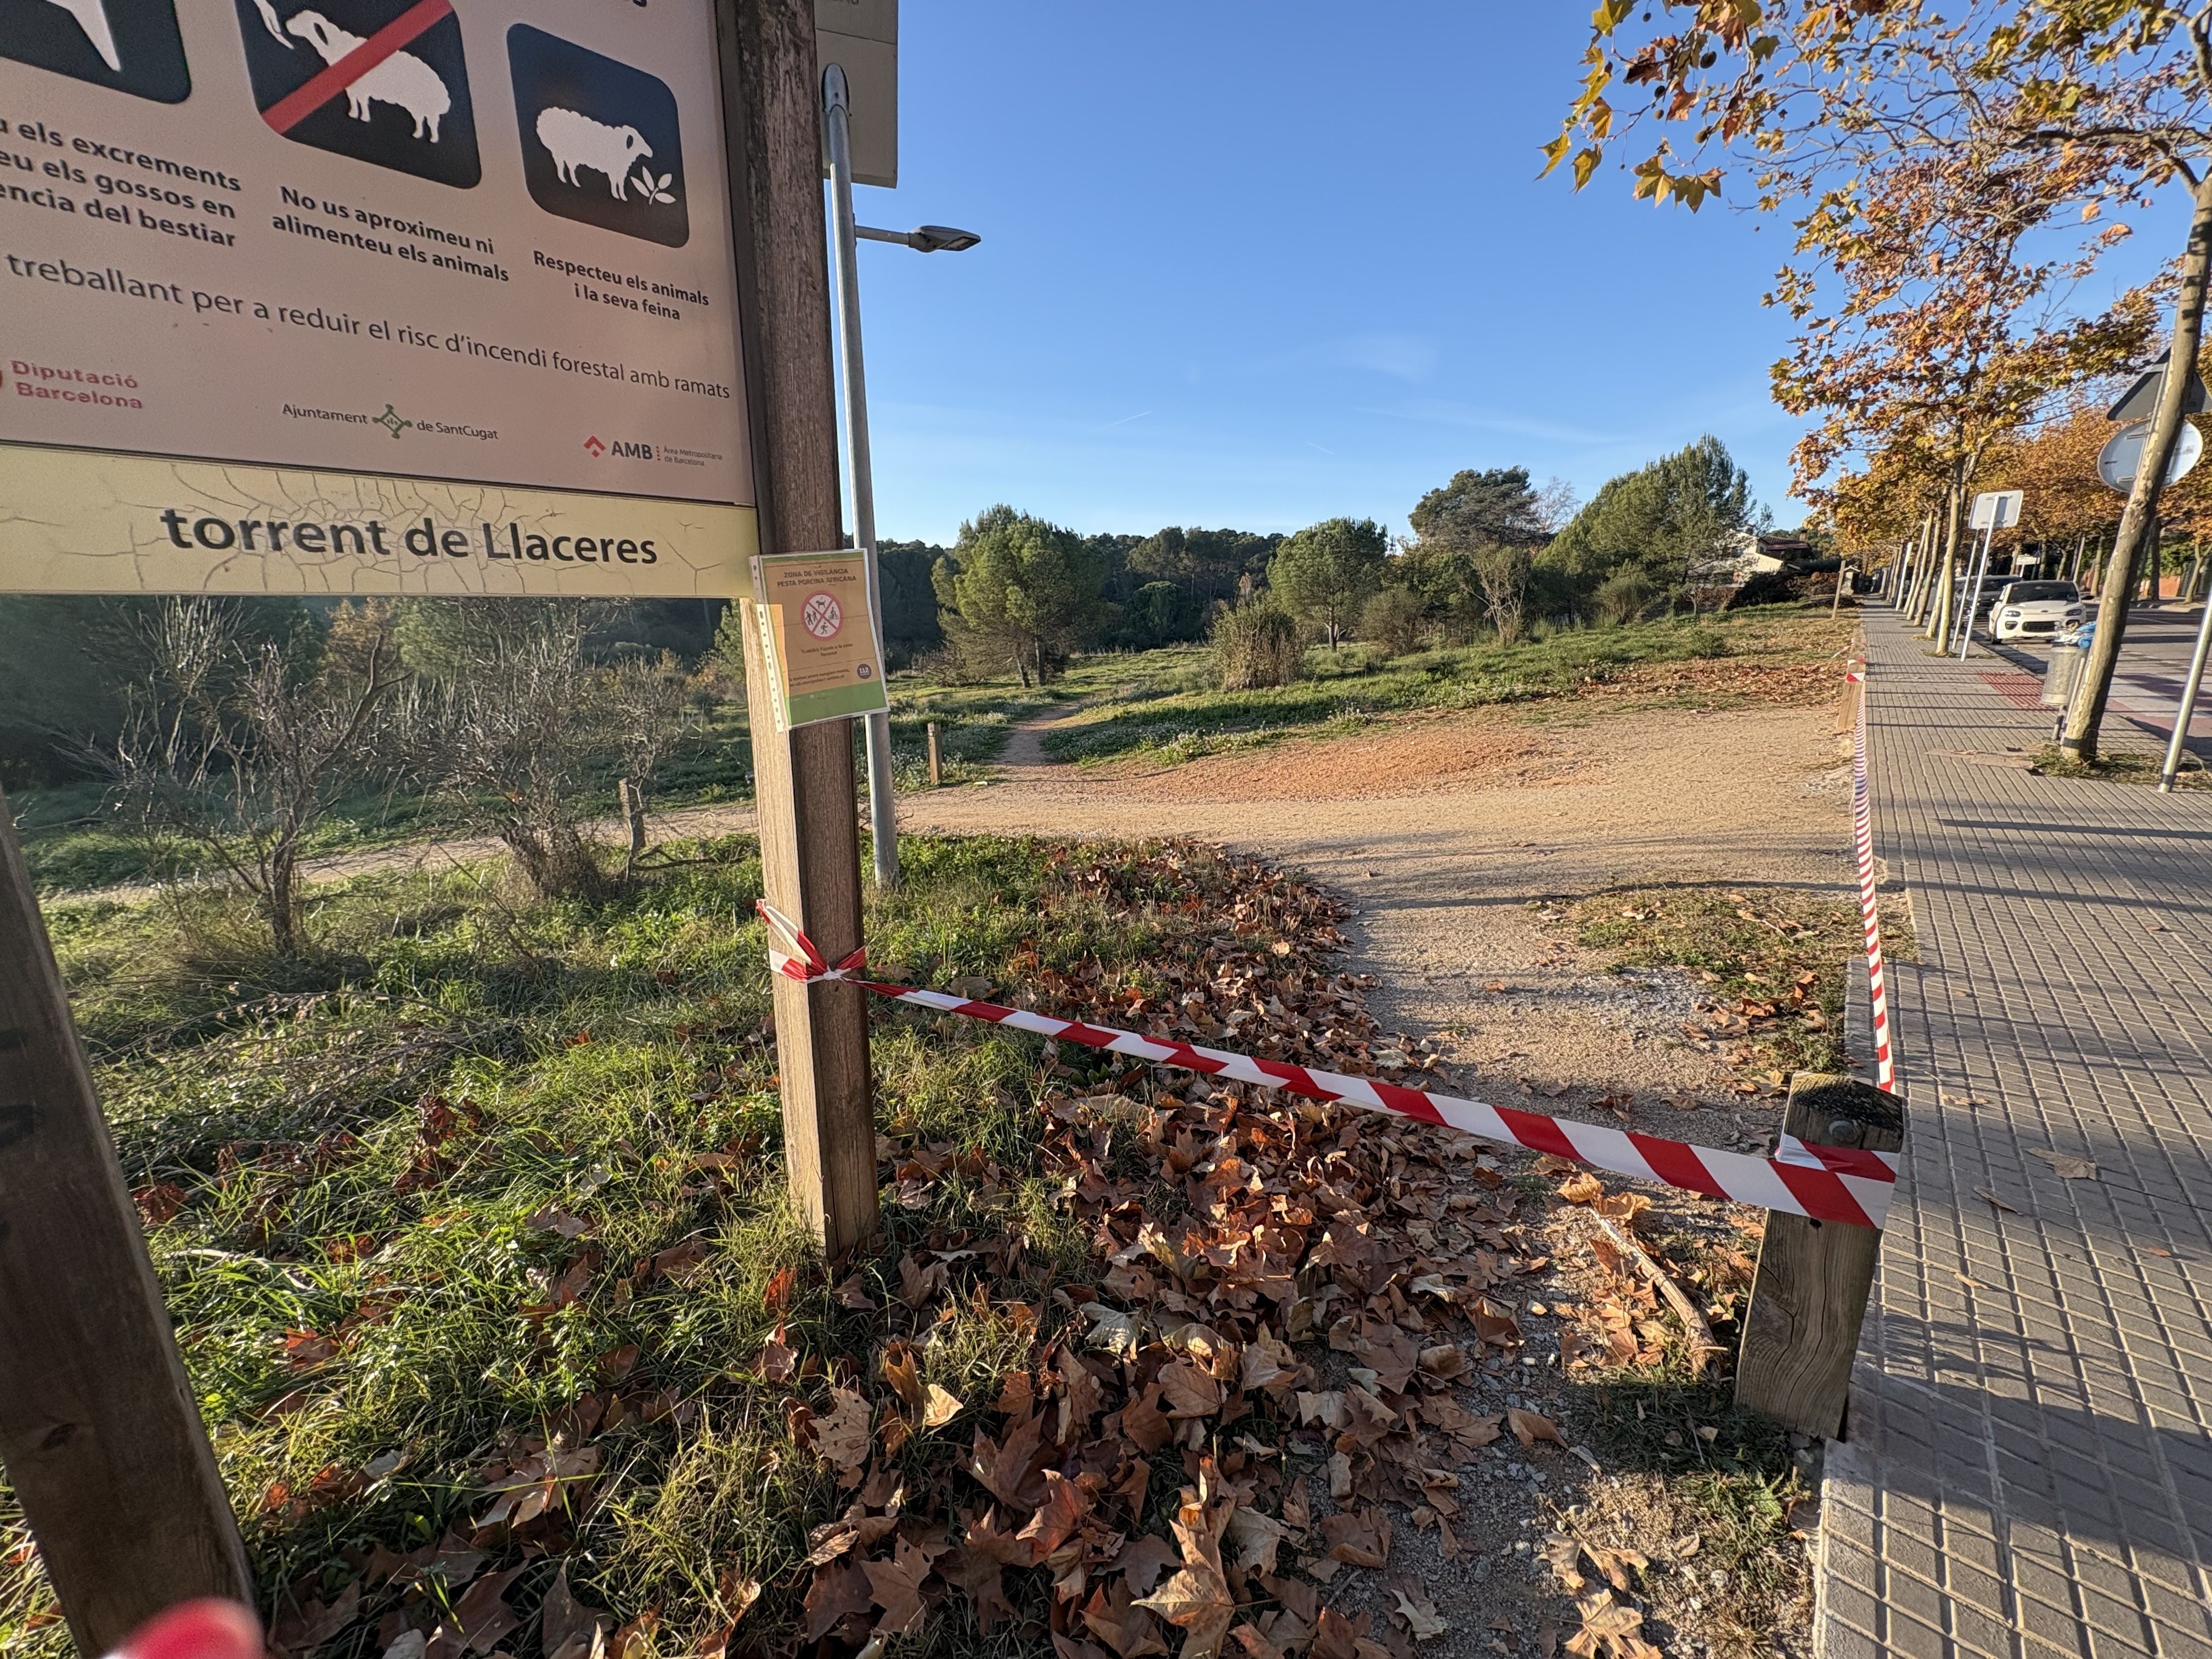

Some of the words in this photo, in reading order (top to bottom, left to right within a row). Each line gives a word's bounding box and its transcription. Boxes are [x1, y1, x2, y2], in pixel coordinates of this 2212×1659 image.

[18, 122, 63, 147] els
[72, 137, 241, 191] excrements
[43, 159, 86, 184] els
[94, 173, 195, 210] gossos
[202, 199, 236, 219] en
[84, 199, 131, 224] del
[137, 208, 236, 247] bestiar
[280, 185, 317, 210] No
[323, 201, 349, 218] us
[354, 209, 471, 249] aproximeu
[475, 238, 495, 255] ni
[272, 215, 393, 256] alimenteu
[397, 244, 427, 263] els
[432, 253, 510, 282] animals
[533, 250, 622, 285] Respecteu
[627, 275, 648, 291] els
[652, 283, 709, 306] animals
[574, 283, 580, 297] i
[584, 285, 599, 301] la
[603, 293, 639, 311] seva
[642, 298, 680, 320] feina
[4, 253, 183, 304] treballant
[192, 290, 243, 313] per
[253, 302, 270, 319] a
[278, 307, 360, 335] reduir
[369, 320, 390, 341] el
[397, 325, 439, 349] risc
[445, 333, 548, 368] d'incendi
[552, 352, 624, 381] forestal
[630, 370, 669, 388] amb
[674, 377, 730, 399] ramats
[10, 360, 138, 389] Diputació
[15, 382, 143, 409] Barcelona
[283, 403, 369, 425] Ajuntament
[417, 420, 433, 432] de
[436, 421, 498, 441] SantCugat
[611, 441, 653, 460] AMB
[674, 456, 705, 466] Barcelona
[160, 508, 390, 556] torrent
[405, 518, 469, 558] de
[483, 522, 659, 565] Llaceres
